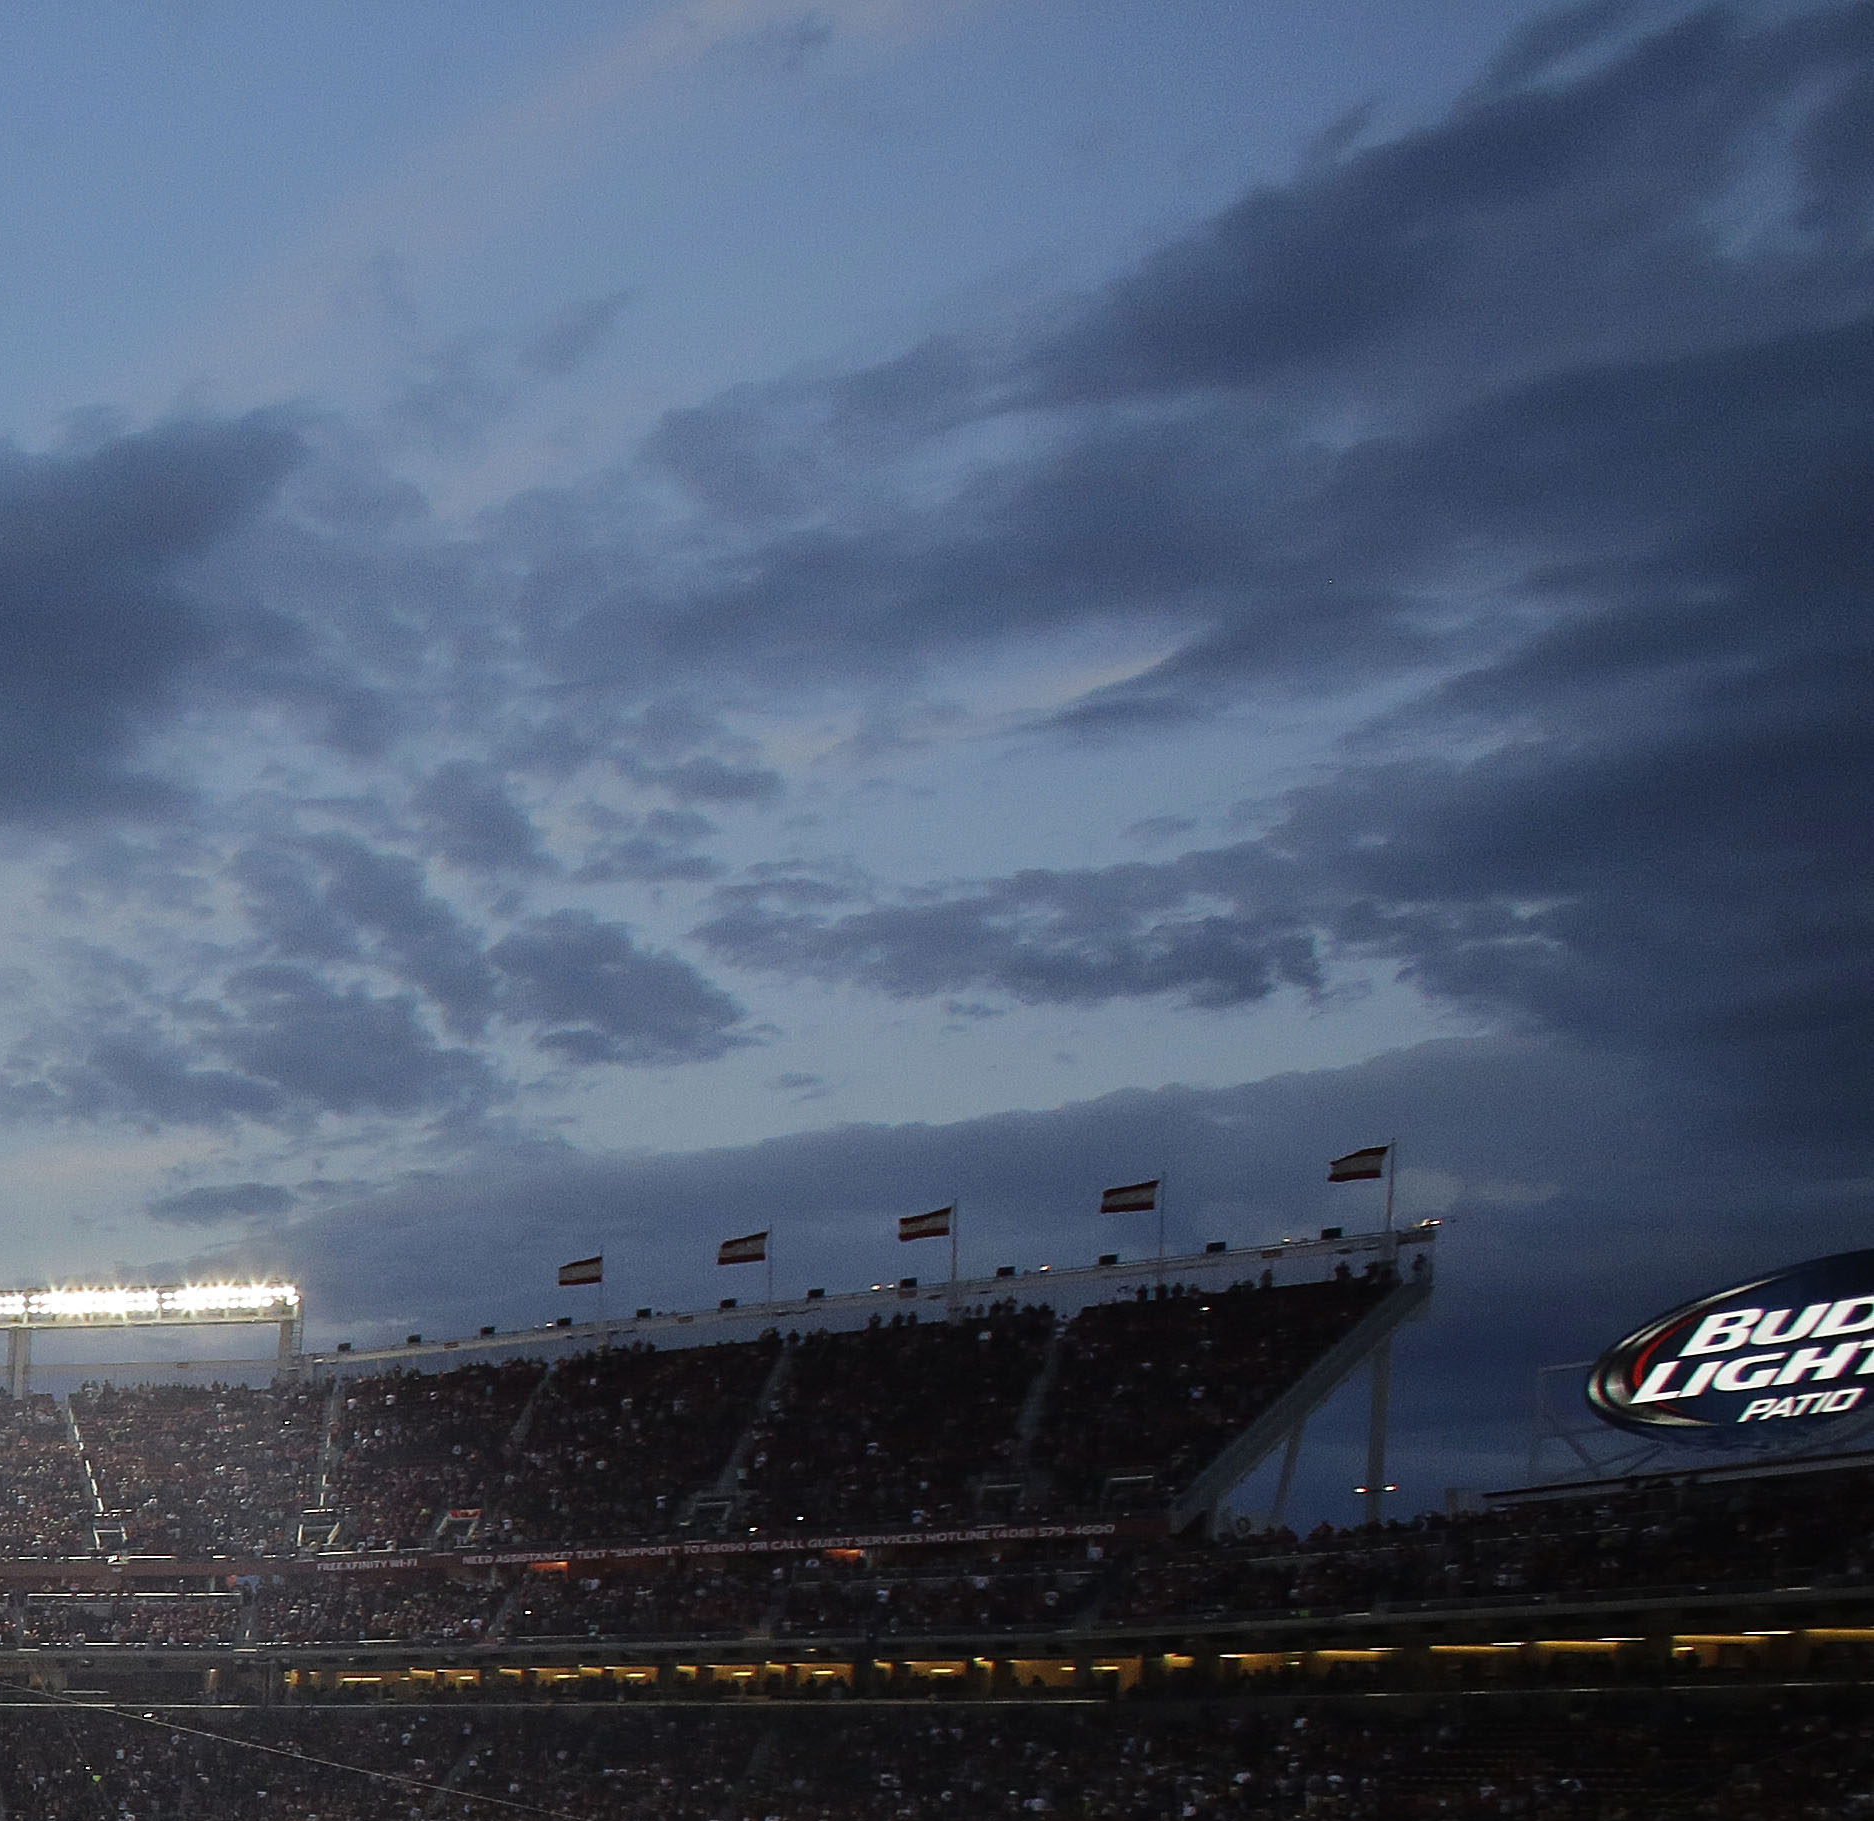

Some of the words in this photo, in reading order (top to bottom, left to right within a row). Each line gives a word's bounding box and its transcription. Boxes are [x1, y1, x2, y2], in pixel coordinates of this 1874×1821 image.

[1677, 1295, 1874, 1358] BUD
[1736, 1387, 1866, 1423] PATIO
[317, 1561, 346, 1571] FREE
[347, 1559, 388, 1570] XFINITY
[461, 1555, 493, 1565] NEED
[576, 1549, 607, 1559] TEXT
[684, 1545, 701, 1554] TO
[748, 1541, 768, 1551] OR
[770, 1540, 805, 1550] CALL
[807, 1536, 854, 1547] GUEST
[855, 1534, 923, 1547] SERVICES
[925, 1531, 991, 1543] HOTLINE
